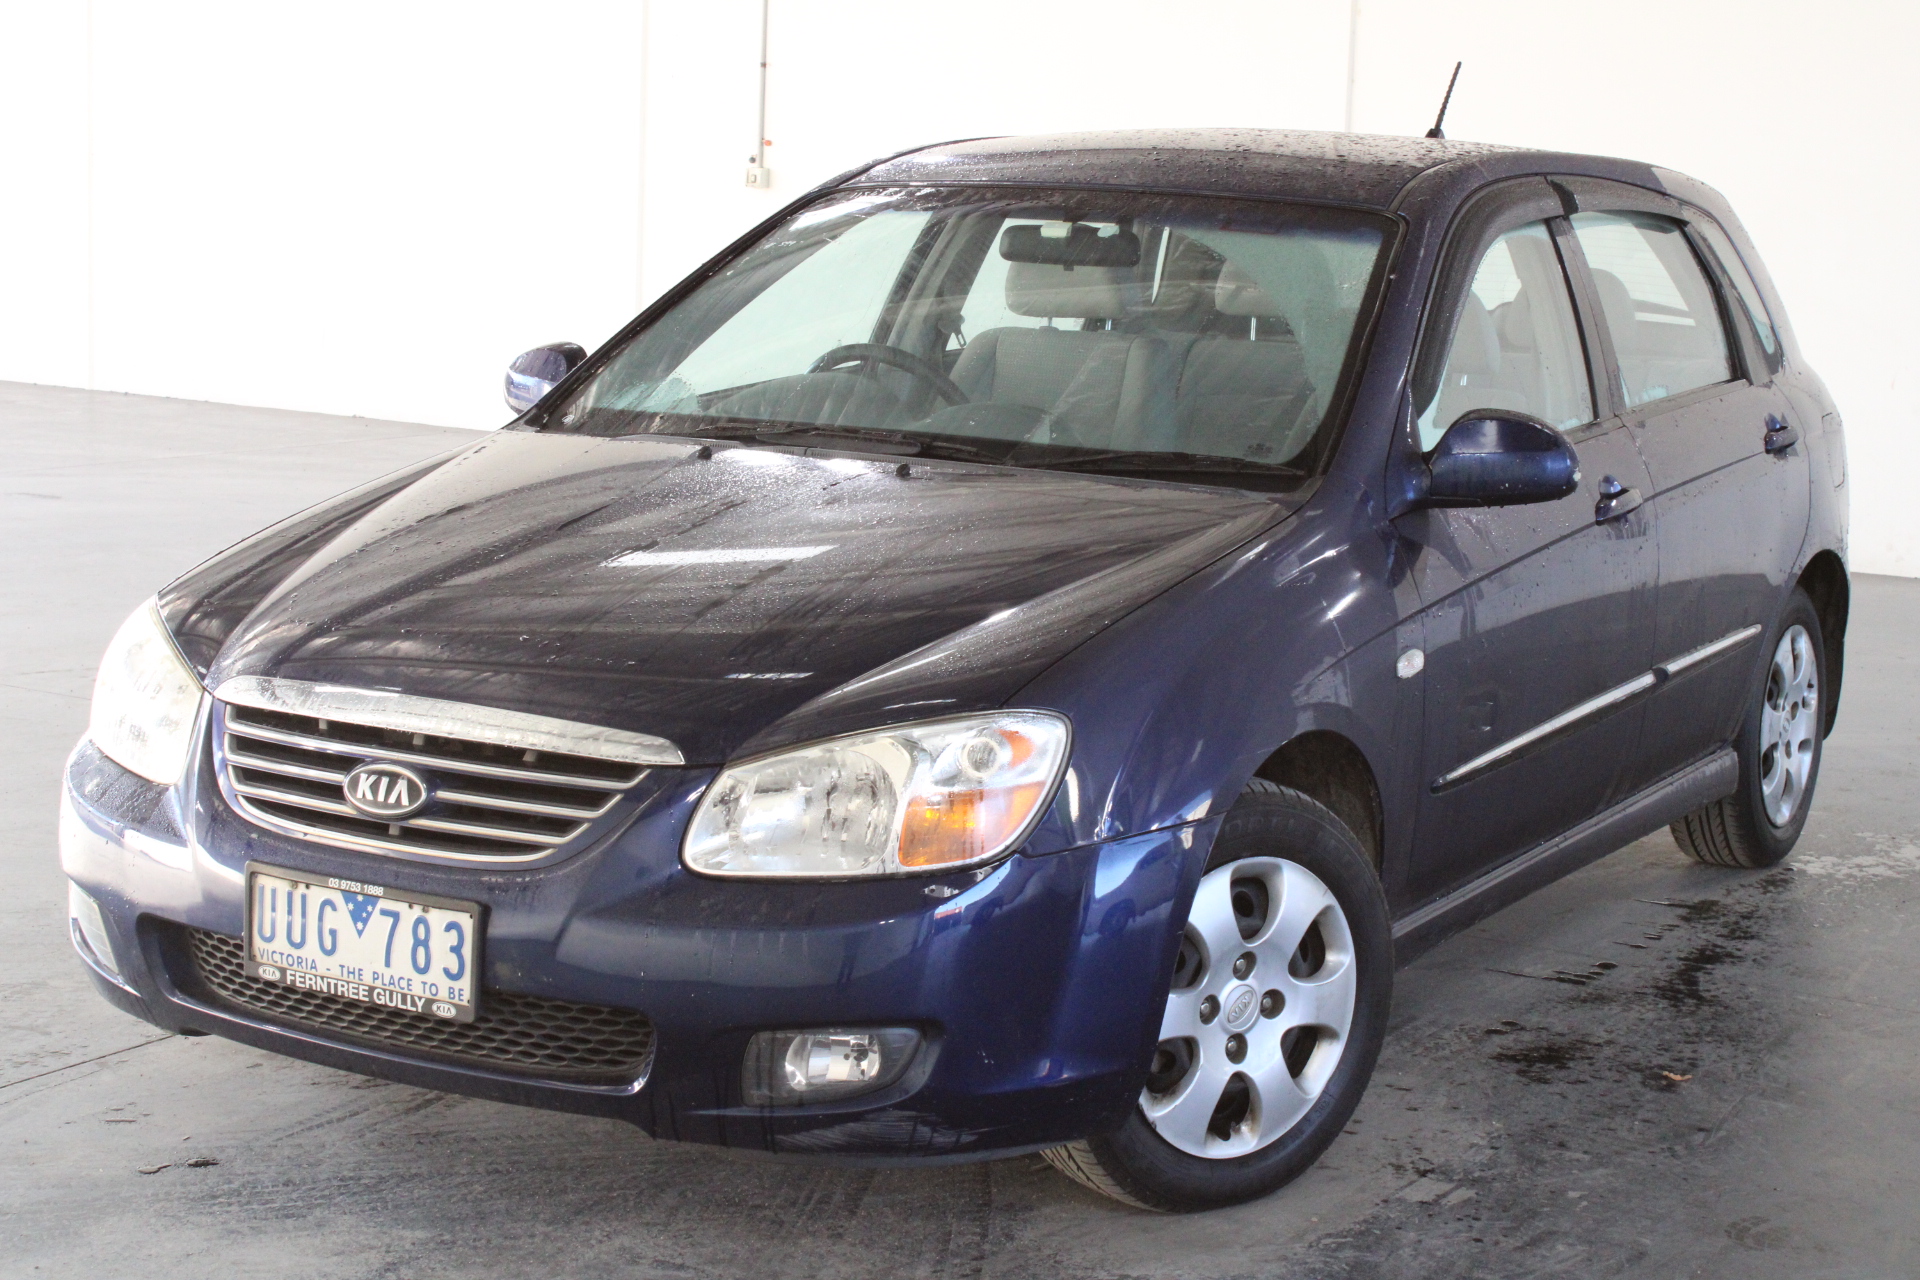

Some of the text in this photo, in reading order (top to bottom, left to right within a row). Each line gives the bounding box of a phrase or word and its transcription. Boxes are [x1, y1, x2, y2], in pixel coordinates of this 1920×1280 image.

[356, 772, 410, 806] KIA
[328, 878, 384, 896] 03 9753 1888
[257, 883, 466, 982] UUG 783
[257, 946, 318, 972] VICTORIA
[338, 964, 364, 982] THE
[372, 970, 413, 992] PLACE
[421, 980, 439, 997] TO
[448, 986, 465, 1002] BE
[262, 968, 452, 1015] KIA FERNTREE GULLY KIA
